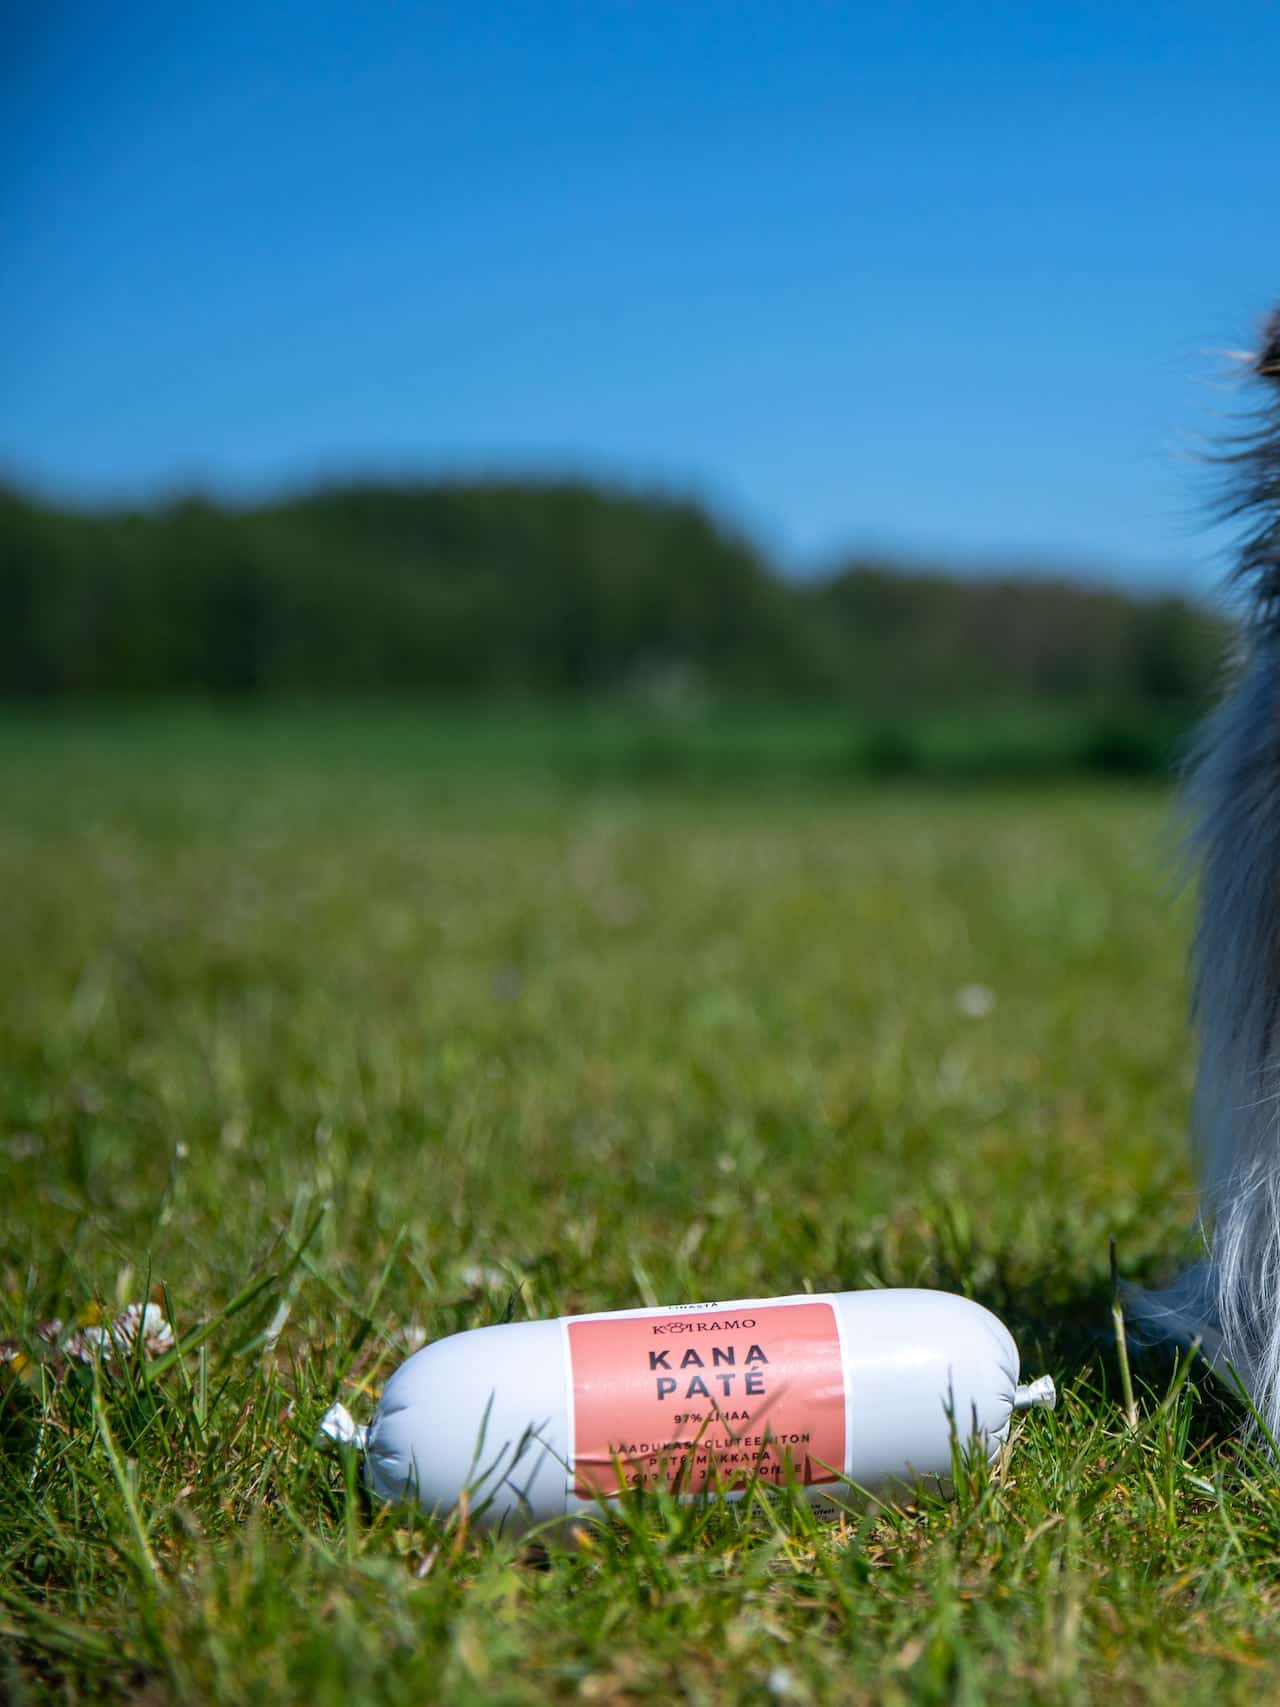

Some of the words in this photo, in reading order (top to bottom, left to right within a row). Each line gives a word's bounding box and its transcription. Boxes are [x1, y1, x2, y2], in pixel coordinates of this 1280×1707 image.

[648, 1344, 769, 1371] KANA
[656, 1367, 766, 1400] PATÉ
[674, 1413, 703, 1425] 97%
